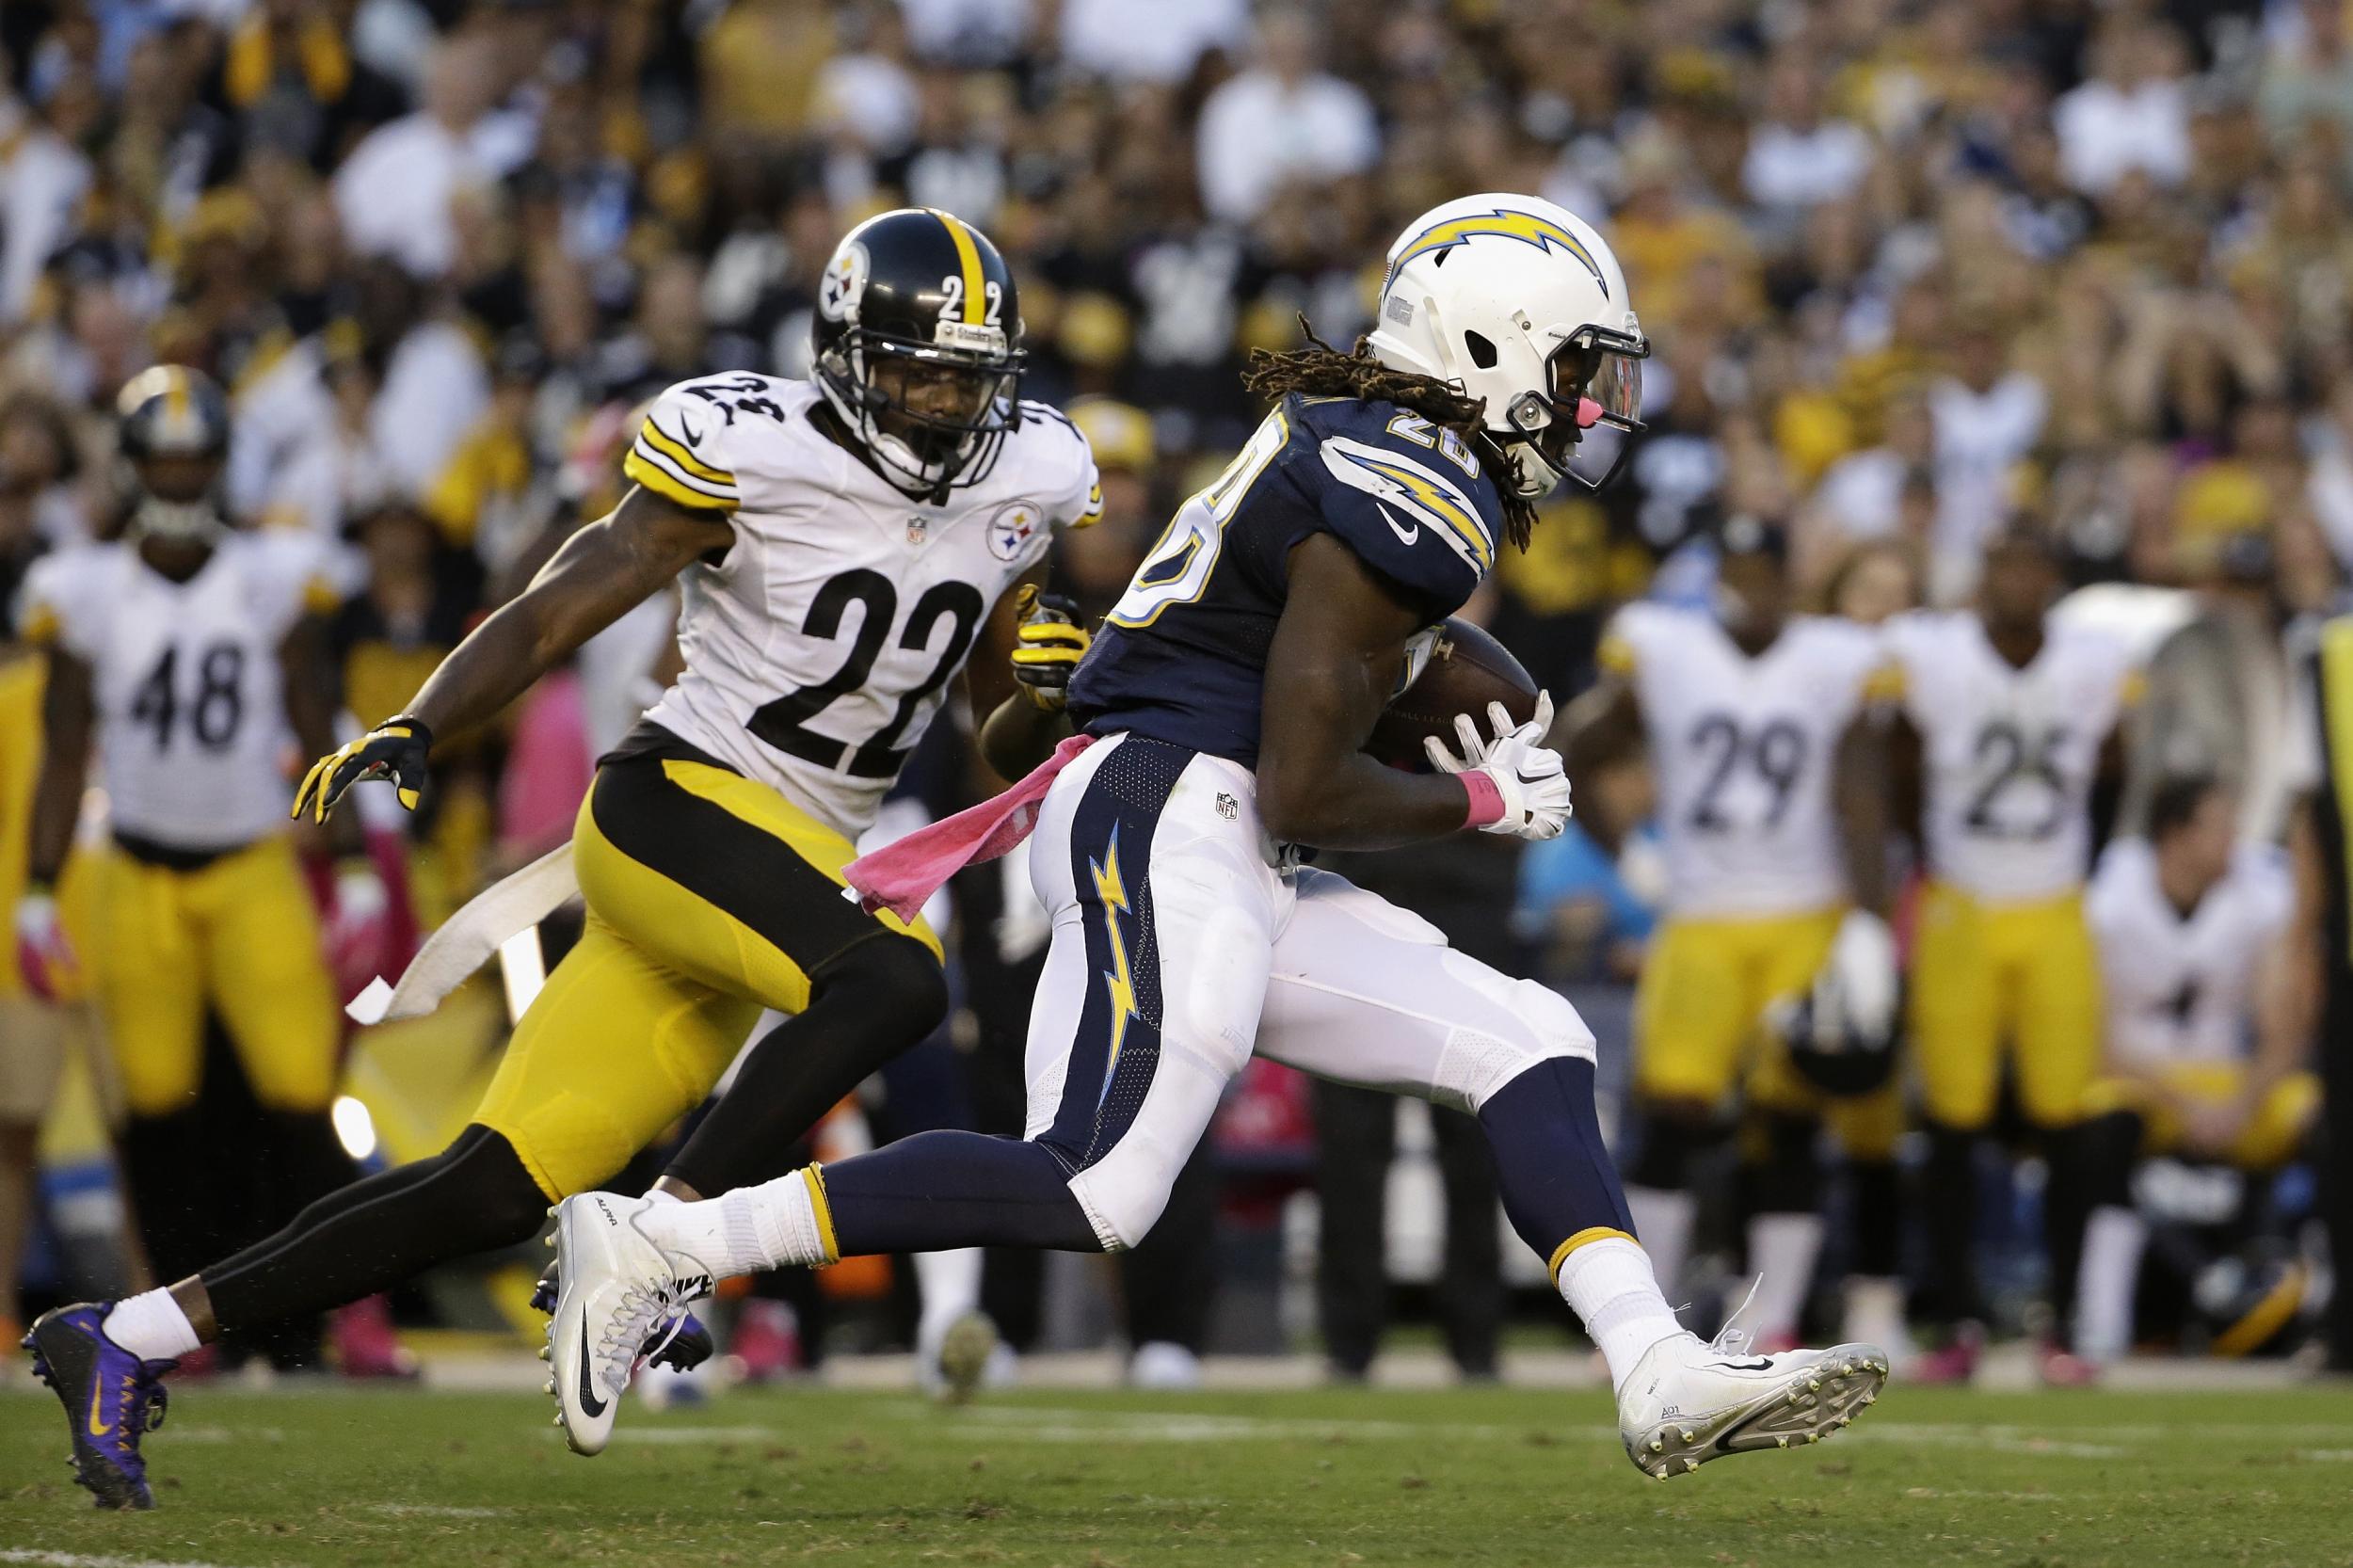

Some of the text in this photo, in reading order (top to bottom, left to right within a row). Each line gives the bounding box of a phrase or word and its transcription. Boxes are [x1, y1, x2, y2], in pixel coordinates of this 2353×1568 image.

[130, 642, 246, 757] 48
[744, 568, 984, 779] 22
[1687, 717, 1808, 835] 29
[595, 1196, 618, 1226] ALPHA
